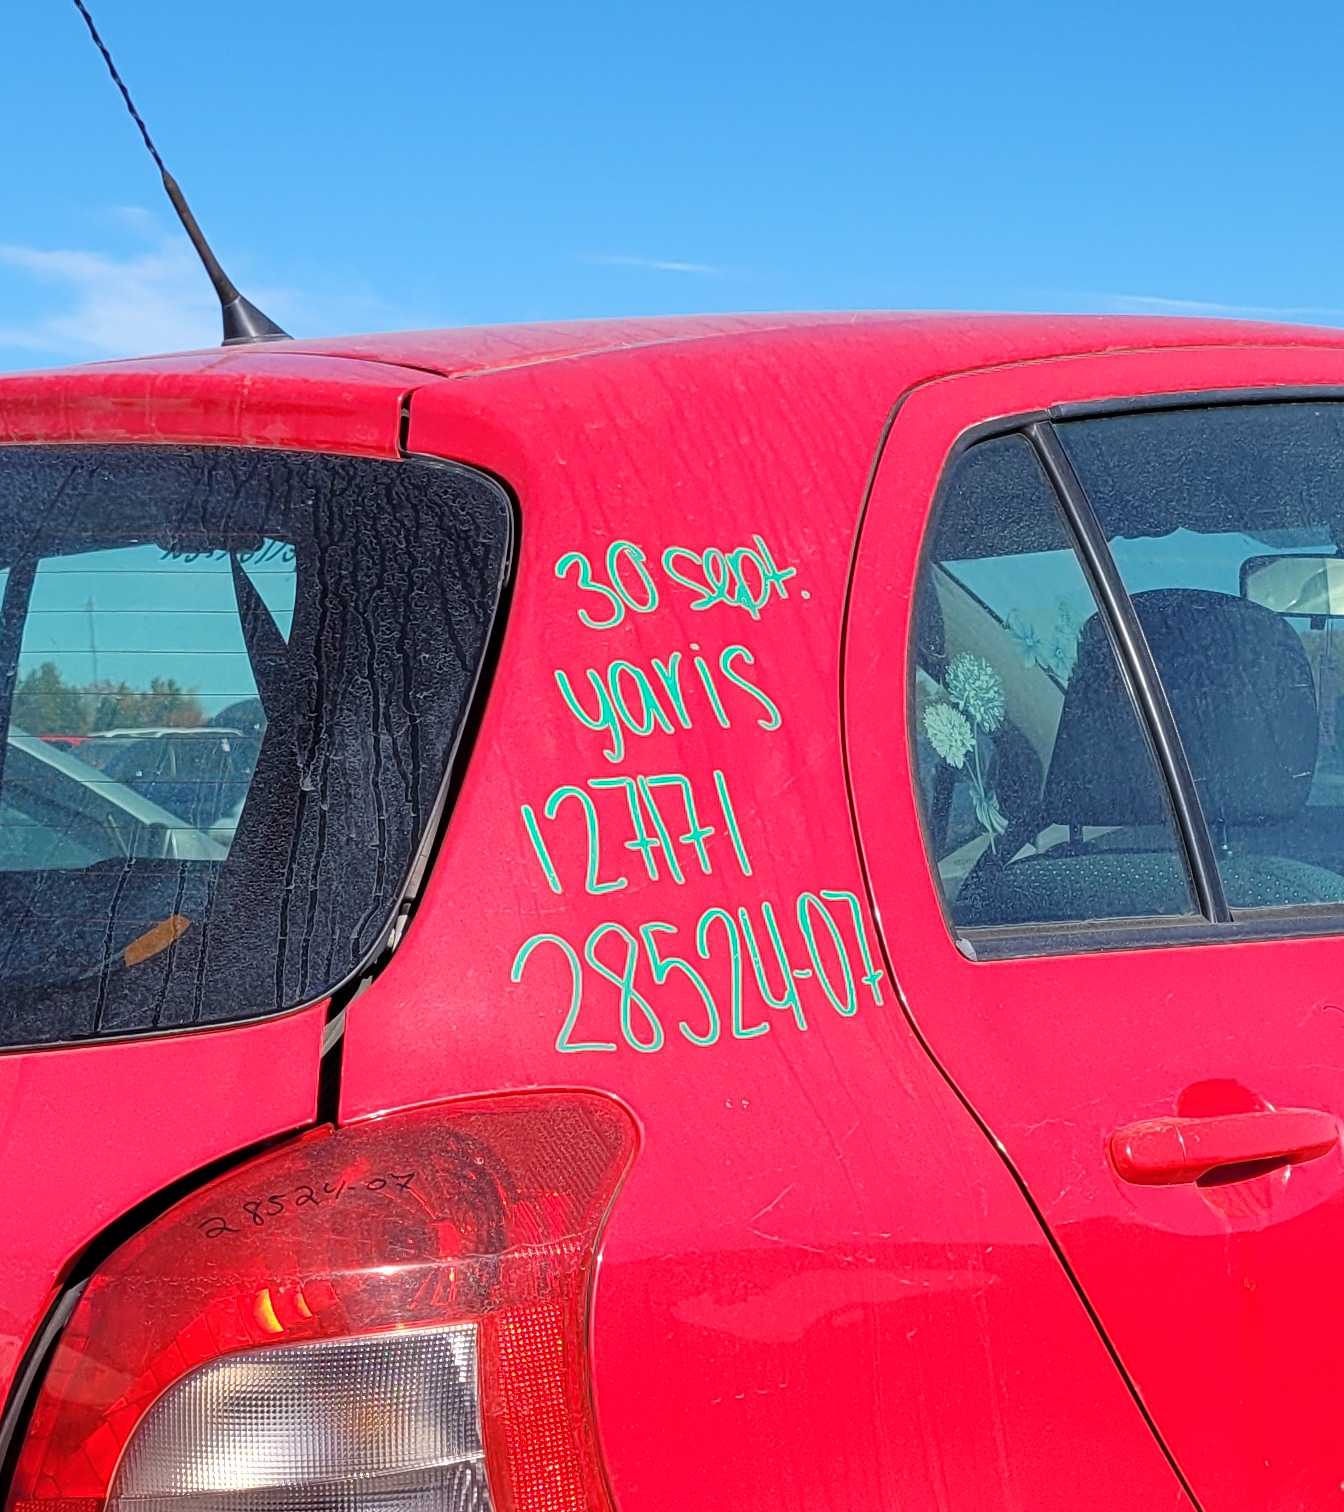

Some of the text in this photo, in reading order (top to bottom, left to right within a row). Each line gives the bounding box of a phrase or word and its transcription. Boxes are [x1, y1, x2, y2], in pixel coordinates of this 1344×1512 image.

[555, 535, 810, 628] 30 sept.
[555, 643, 781, 763] yaris
[511, 890, 884, 1053] 28524-07
